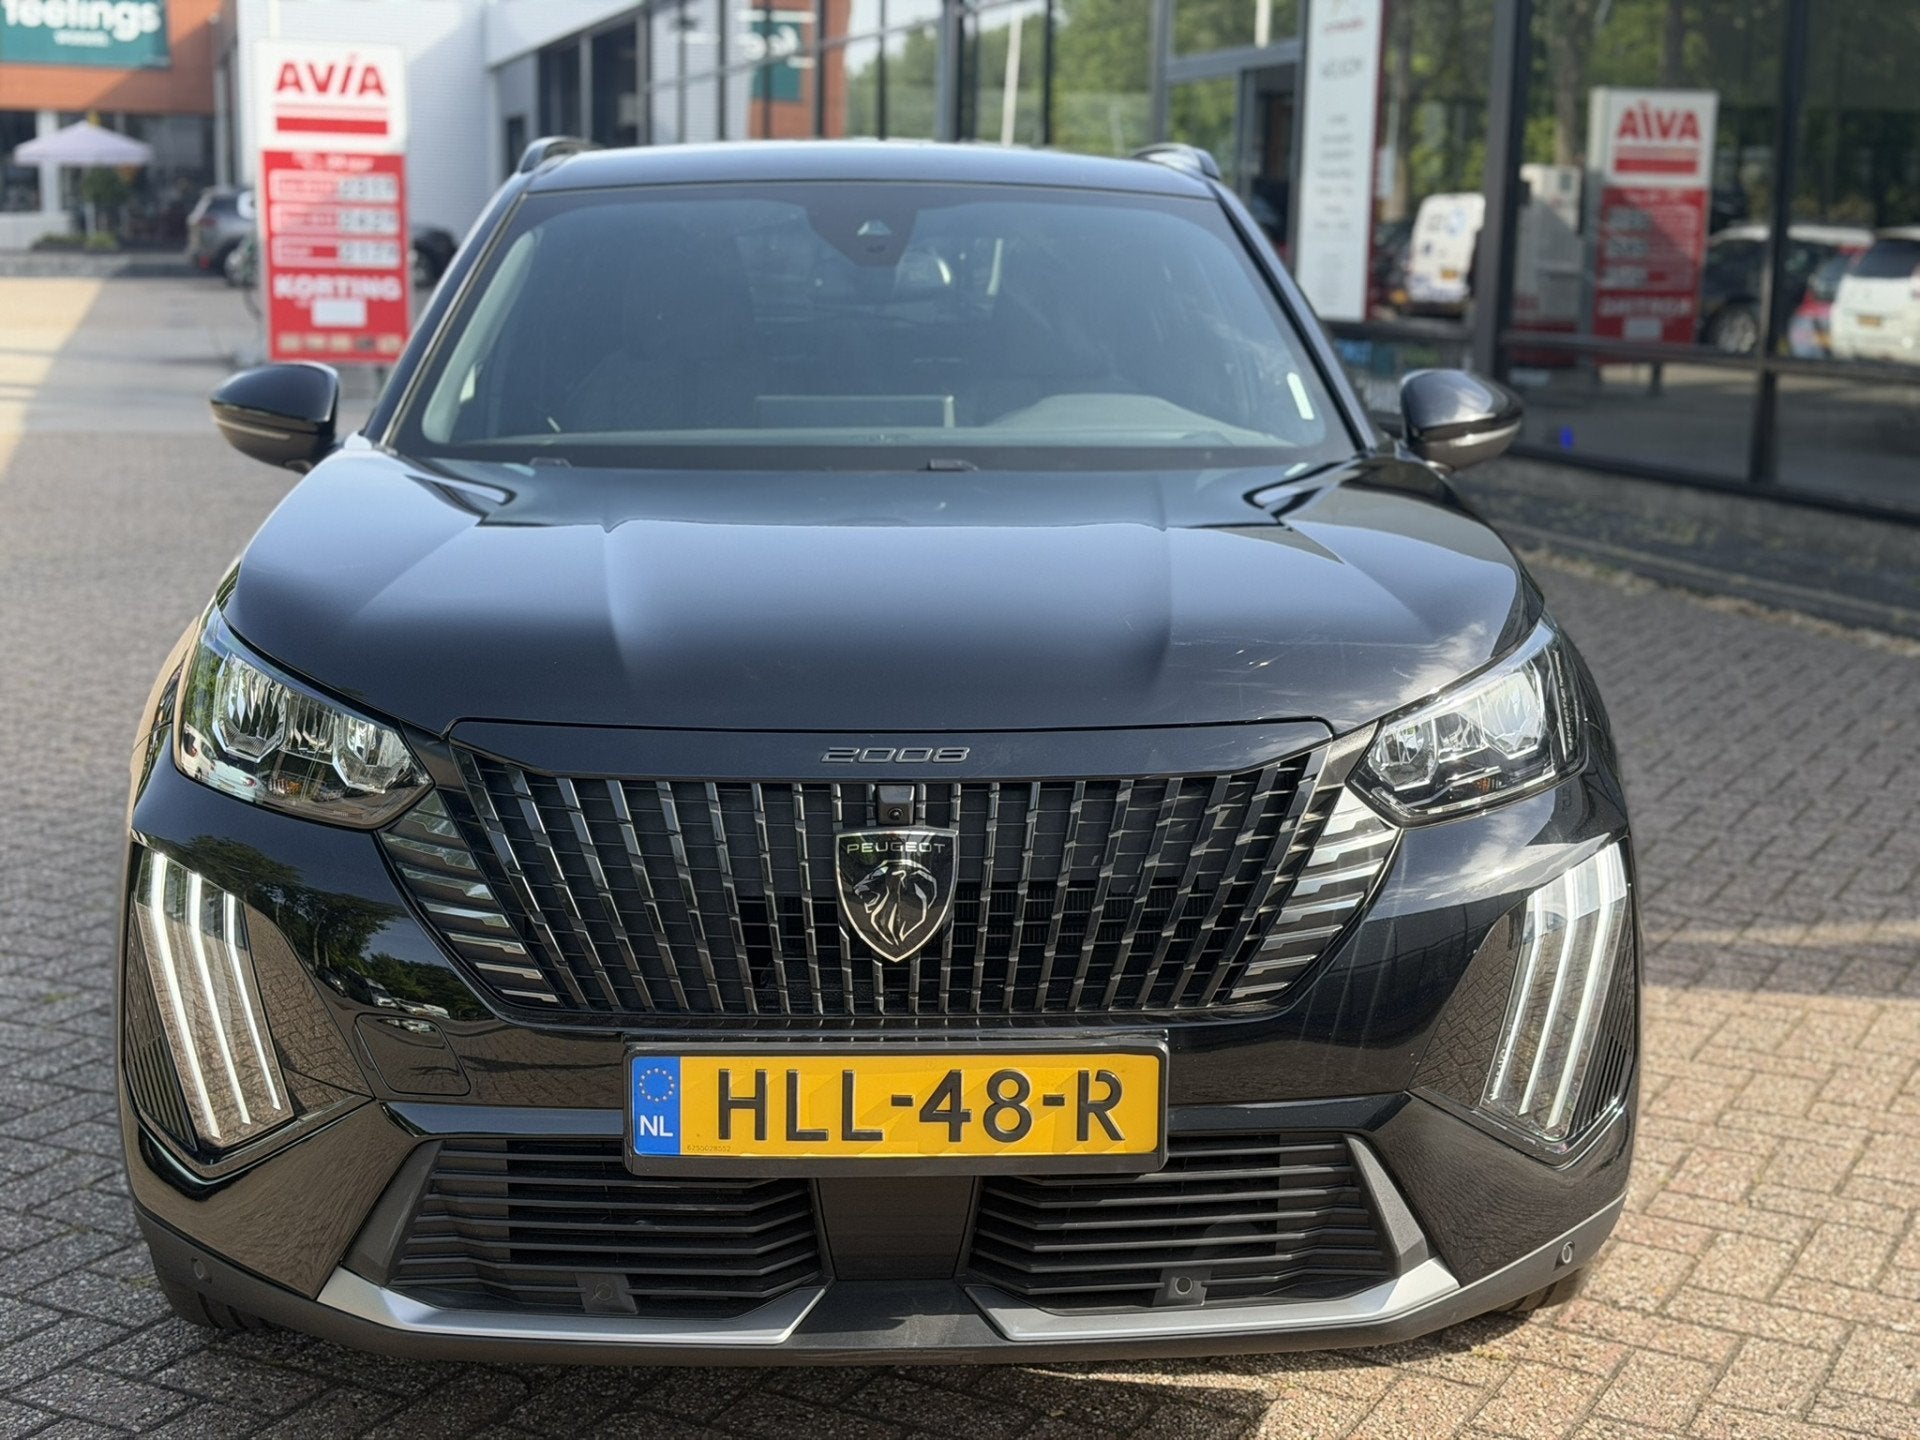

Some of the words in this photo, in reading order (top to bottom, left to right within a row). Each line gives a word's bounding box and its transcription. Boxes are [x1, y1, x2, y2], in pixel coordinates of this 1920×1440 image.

[821, 747, 970, 763] 2008
[847, 841, 945, 853] PEUGEOT
[719, 1068, 1125, 1143] HLL-48-R
[640, 1115, 674, 1137] NL
